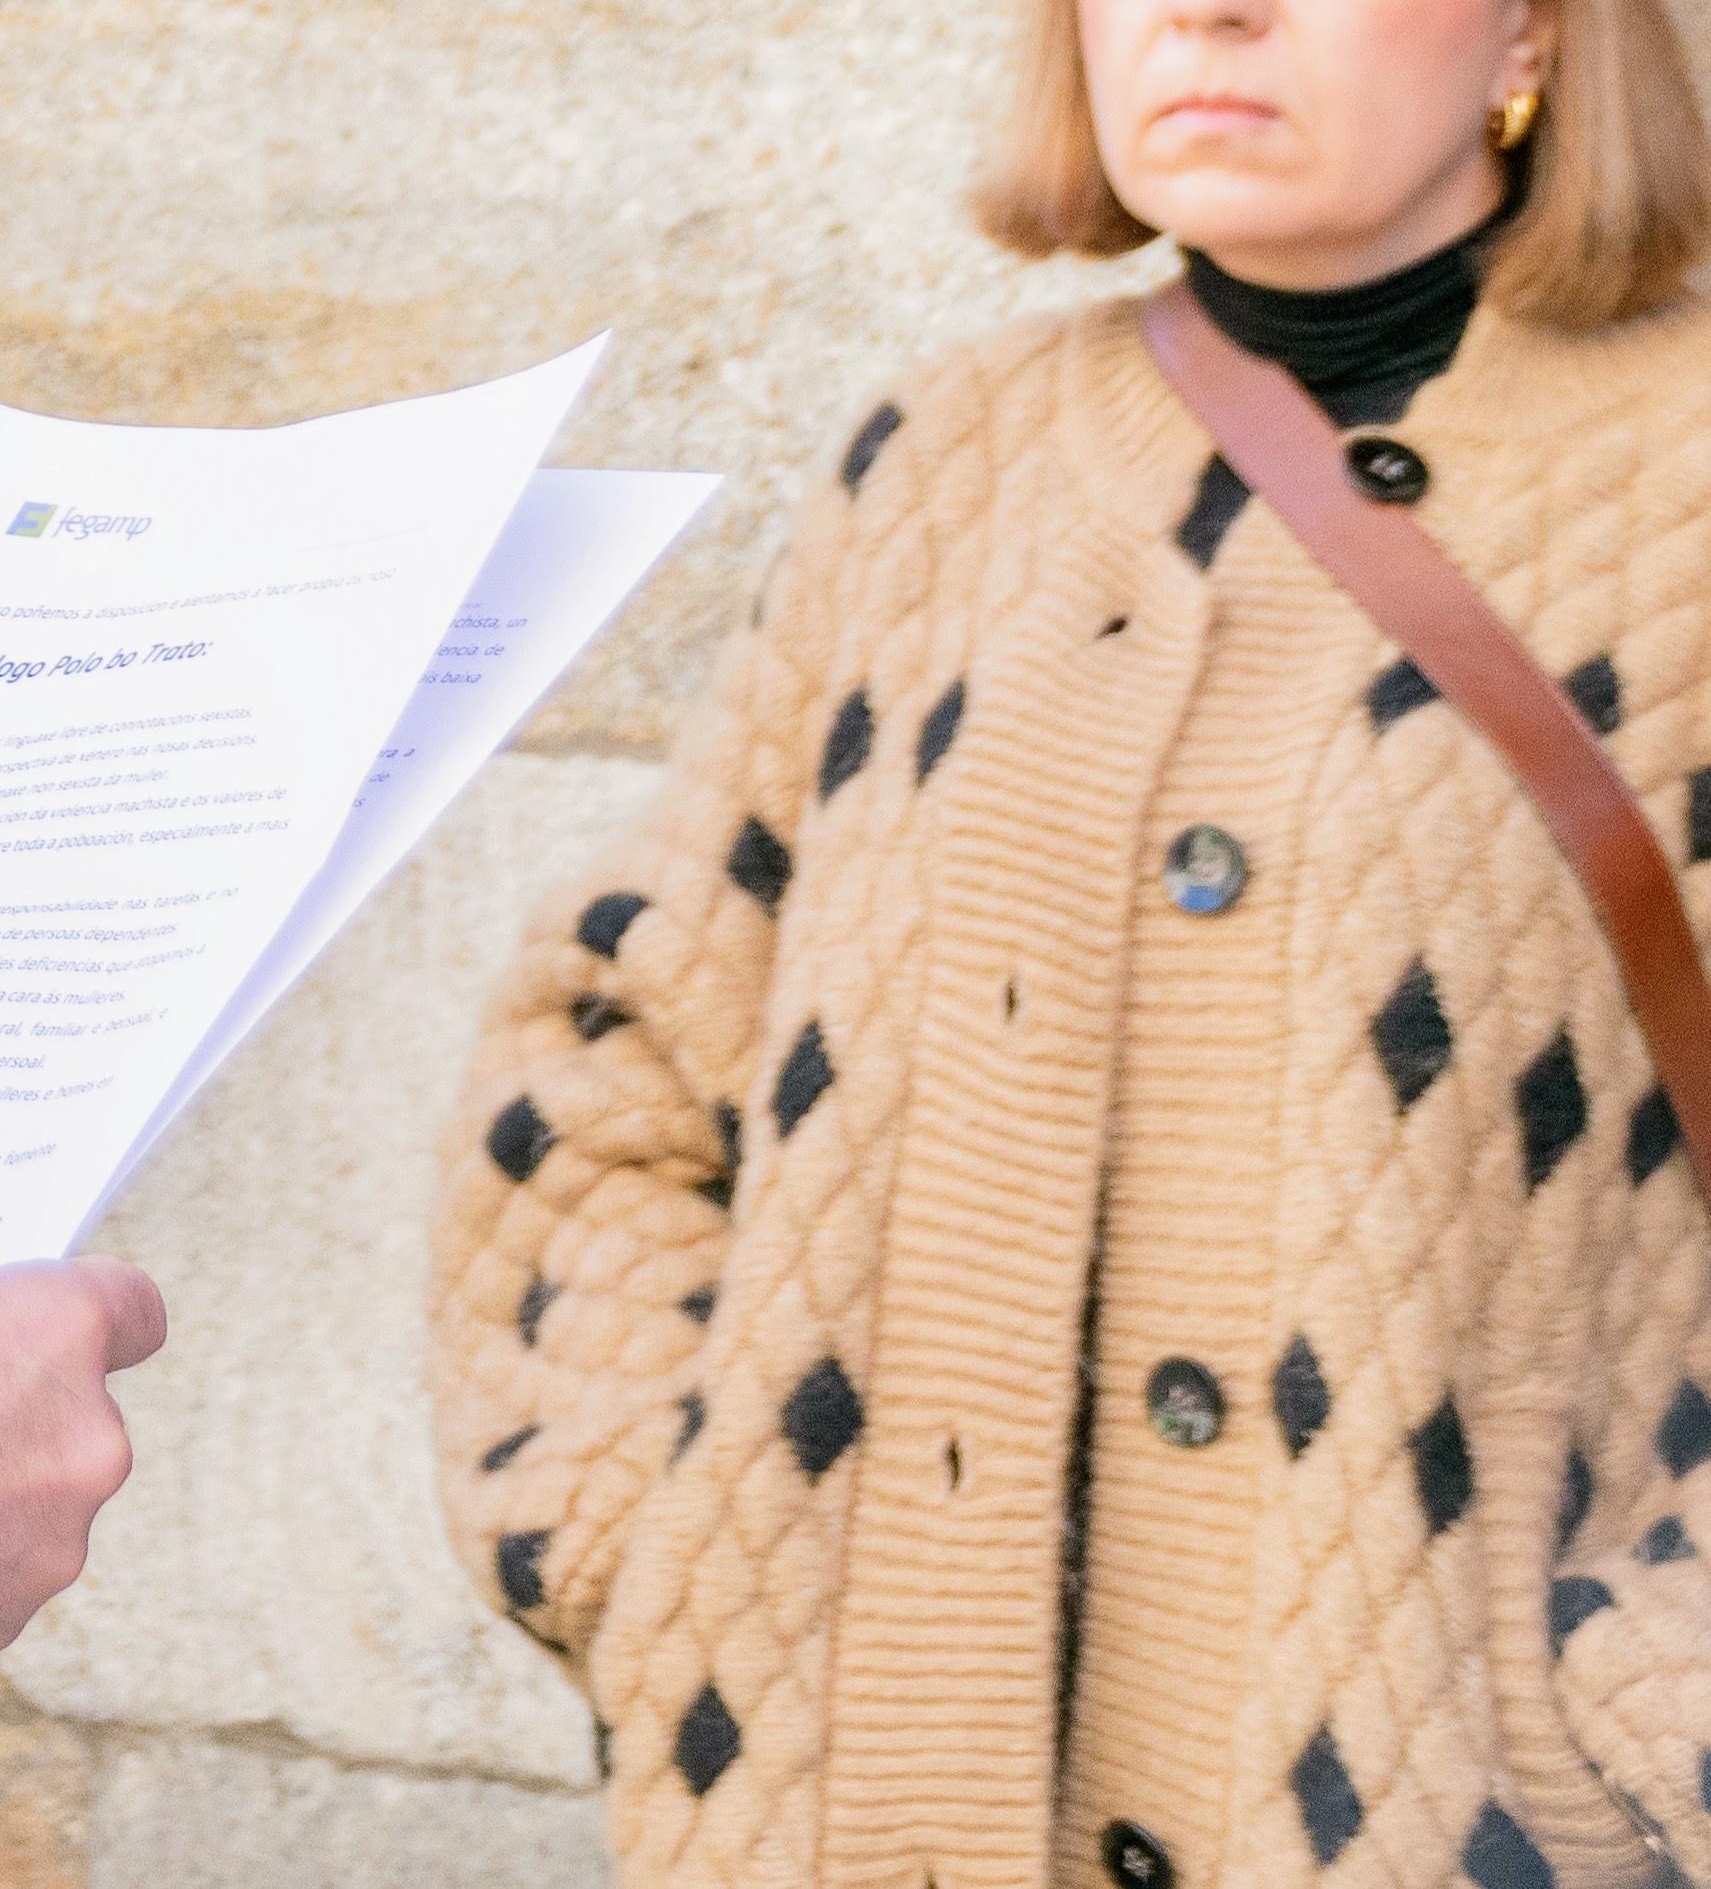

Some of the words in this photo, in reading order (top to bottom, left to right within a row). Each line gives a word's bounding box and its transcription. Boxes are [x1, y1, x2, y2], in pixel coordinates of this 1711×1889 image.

[51, 506, 152, 541] fegamp
[450, 615, 502, 630] chista,
[46, 650, 104, 678] Polo
[104, 650, 139, 672] bo
[140, 638, 215, 665] Trato:
[7, 991, 43, 1003] cara
[29, 1019, 88, 1038] familiar
